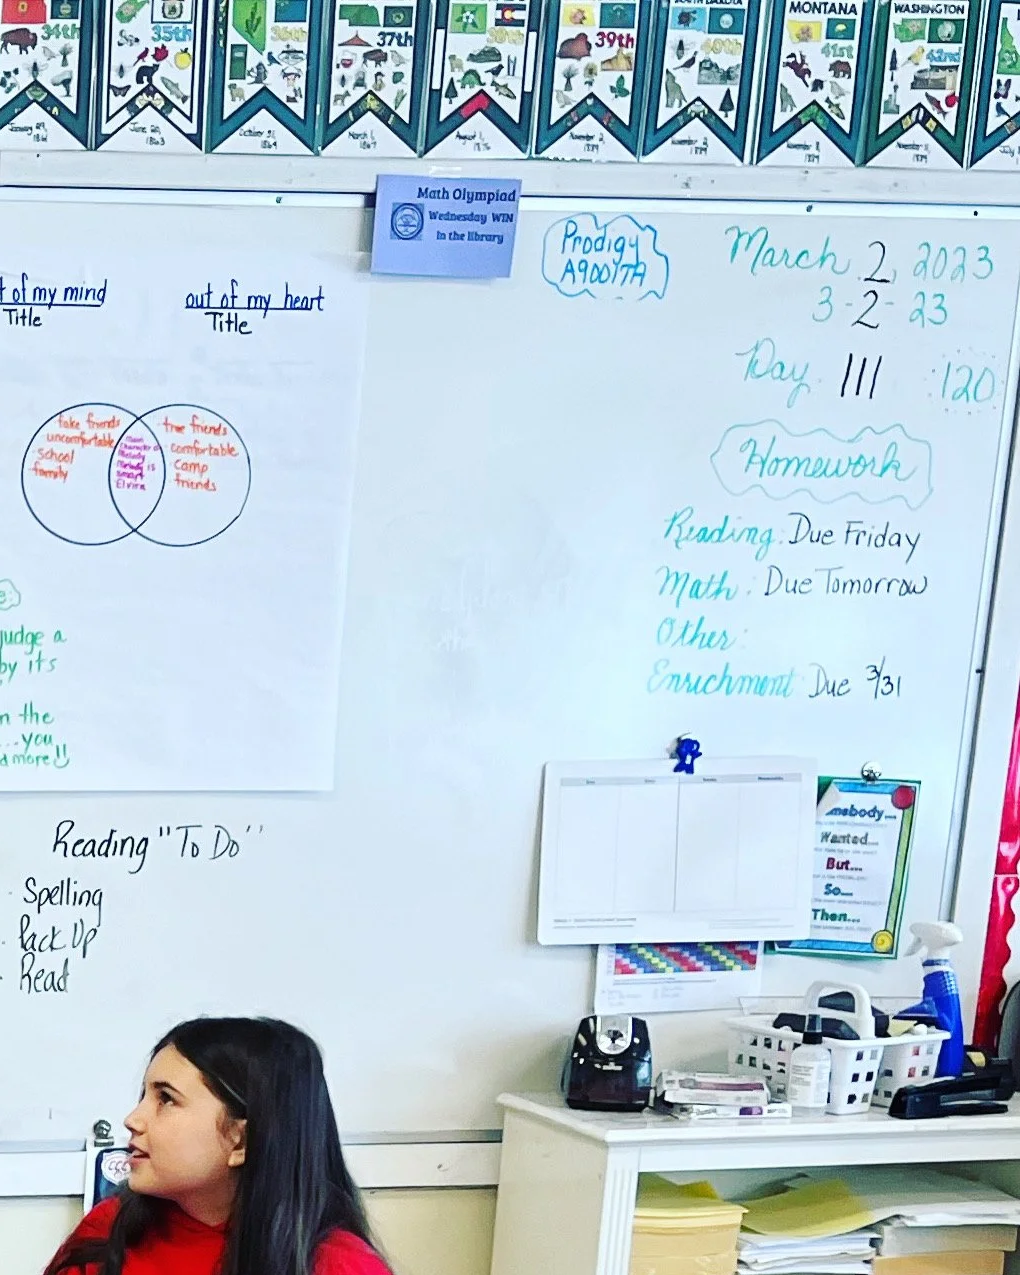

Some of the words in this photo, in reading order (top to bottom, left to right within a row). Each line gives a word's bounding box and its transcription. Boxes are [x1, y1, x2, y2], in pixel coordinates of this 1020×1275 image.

[788, 1, 857, 16] MONTANA
[894, 3, 965, 15] WASHINGTON
[41, 24, 80, 41] 34th
[151, 25, 193, 42] 35th
[377, 31, 414, 48] 37th
[595, 31, 634, 48] 39th
[417, 187, 449, 200] Math
[452, 188, 516, 204] Olympiad
[428, 210, 487, 225] Wednesday
[492, 213, 514, 223] WIN
[449, 231, 465, 241] the
[467, 231, 504, 245] library
[561, 220, 639, 265] Prodigy
[724, 226, 851, 277] March
[913, 241, 994, 281] 2023
[12, 272, 30, 304] of
[33, 286, 57, 309] my
[63, 278, 108, 305] mind
[185, 286, 212, 309] out
[221, 279, 238, 308] of
[247, 292, 272, 319] my
[283, 282, 325, 312] heart
[2, 308, 43, 328] Title
[204, 311, 253, 335] Title
[85, 412, 121, 429] friends
[163, 416, 185, 434] true
[190, 415, 228, 436] friends
[46, 431, 115, 449] uncomfortable
[171, 439, 240, 458] comfortable
[740, 435, 919, 481] Homework
[174, 477, 218, 493] friends
[788, 512, 836, 545] Due
[844, 521, 921, 564] Friday
[765, 565, 813, 596] Due
[815, 566, 929, 597] Tomorrow
[53, 630, 67, 643] a
[28, 650, 57, 674] its
[809, 662, 852, 698] Due
[865, 655, 901, 699] 3/31
[18, 700, 54, 725] the
[52, 820, 148, 874] Reading
[23, 877, 103, 927] Spelling
[18, 914, 67, 952] Pack
[73, 918, 98, 959] Up
[19, 952, 70, 994] Read
